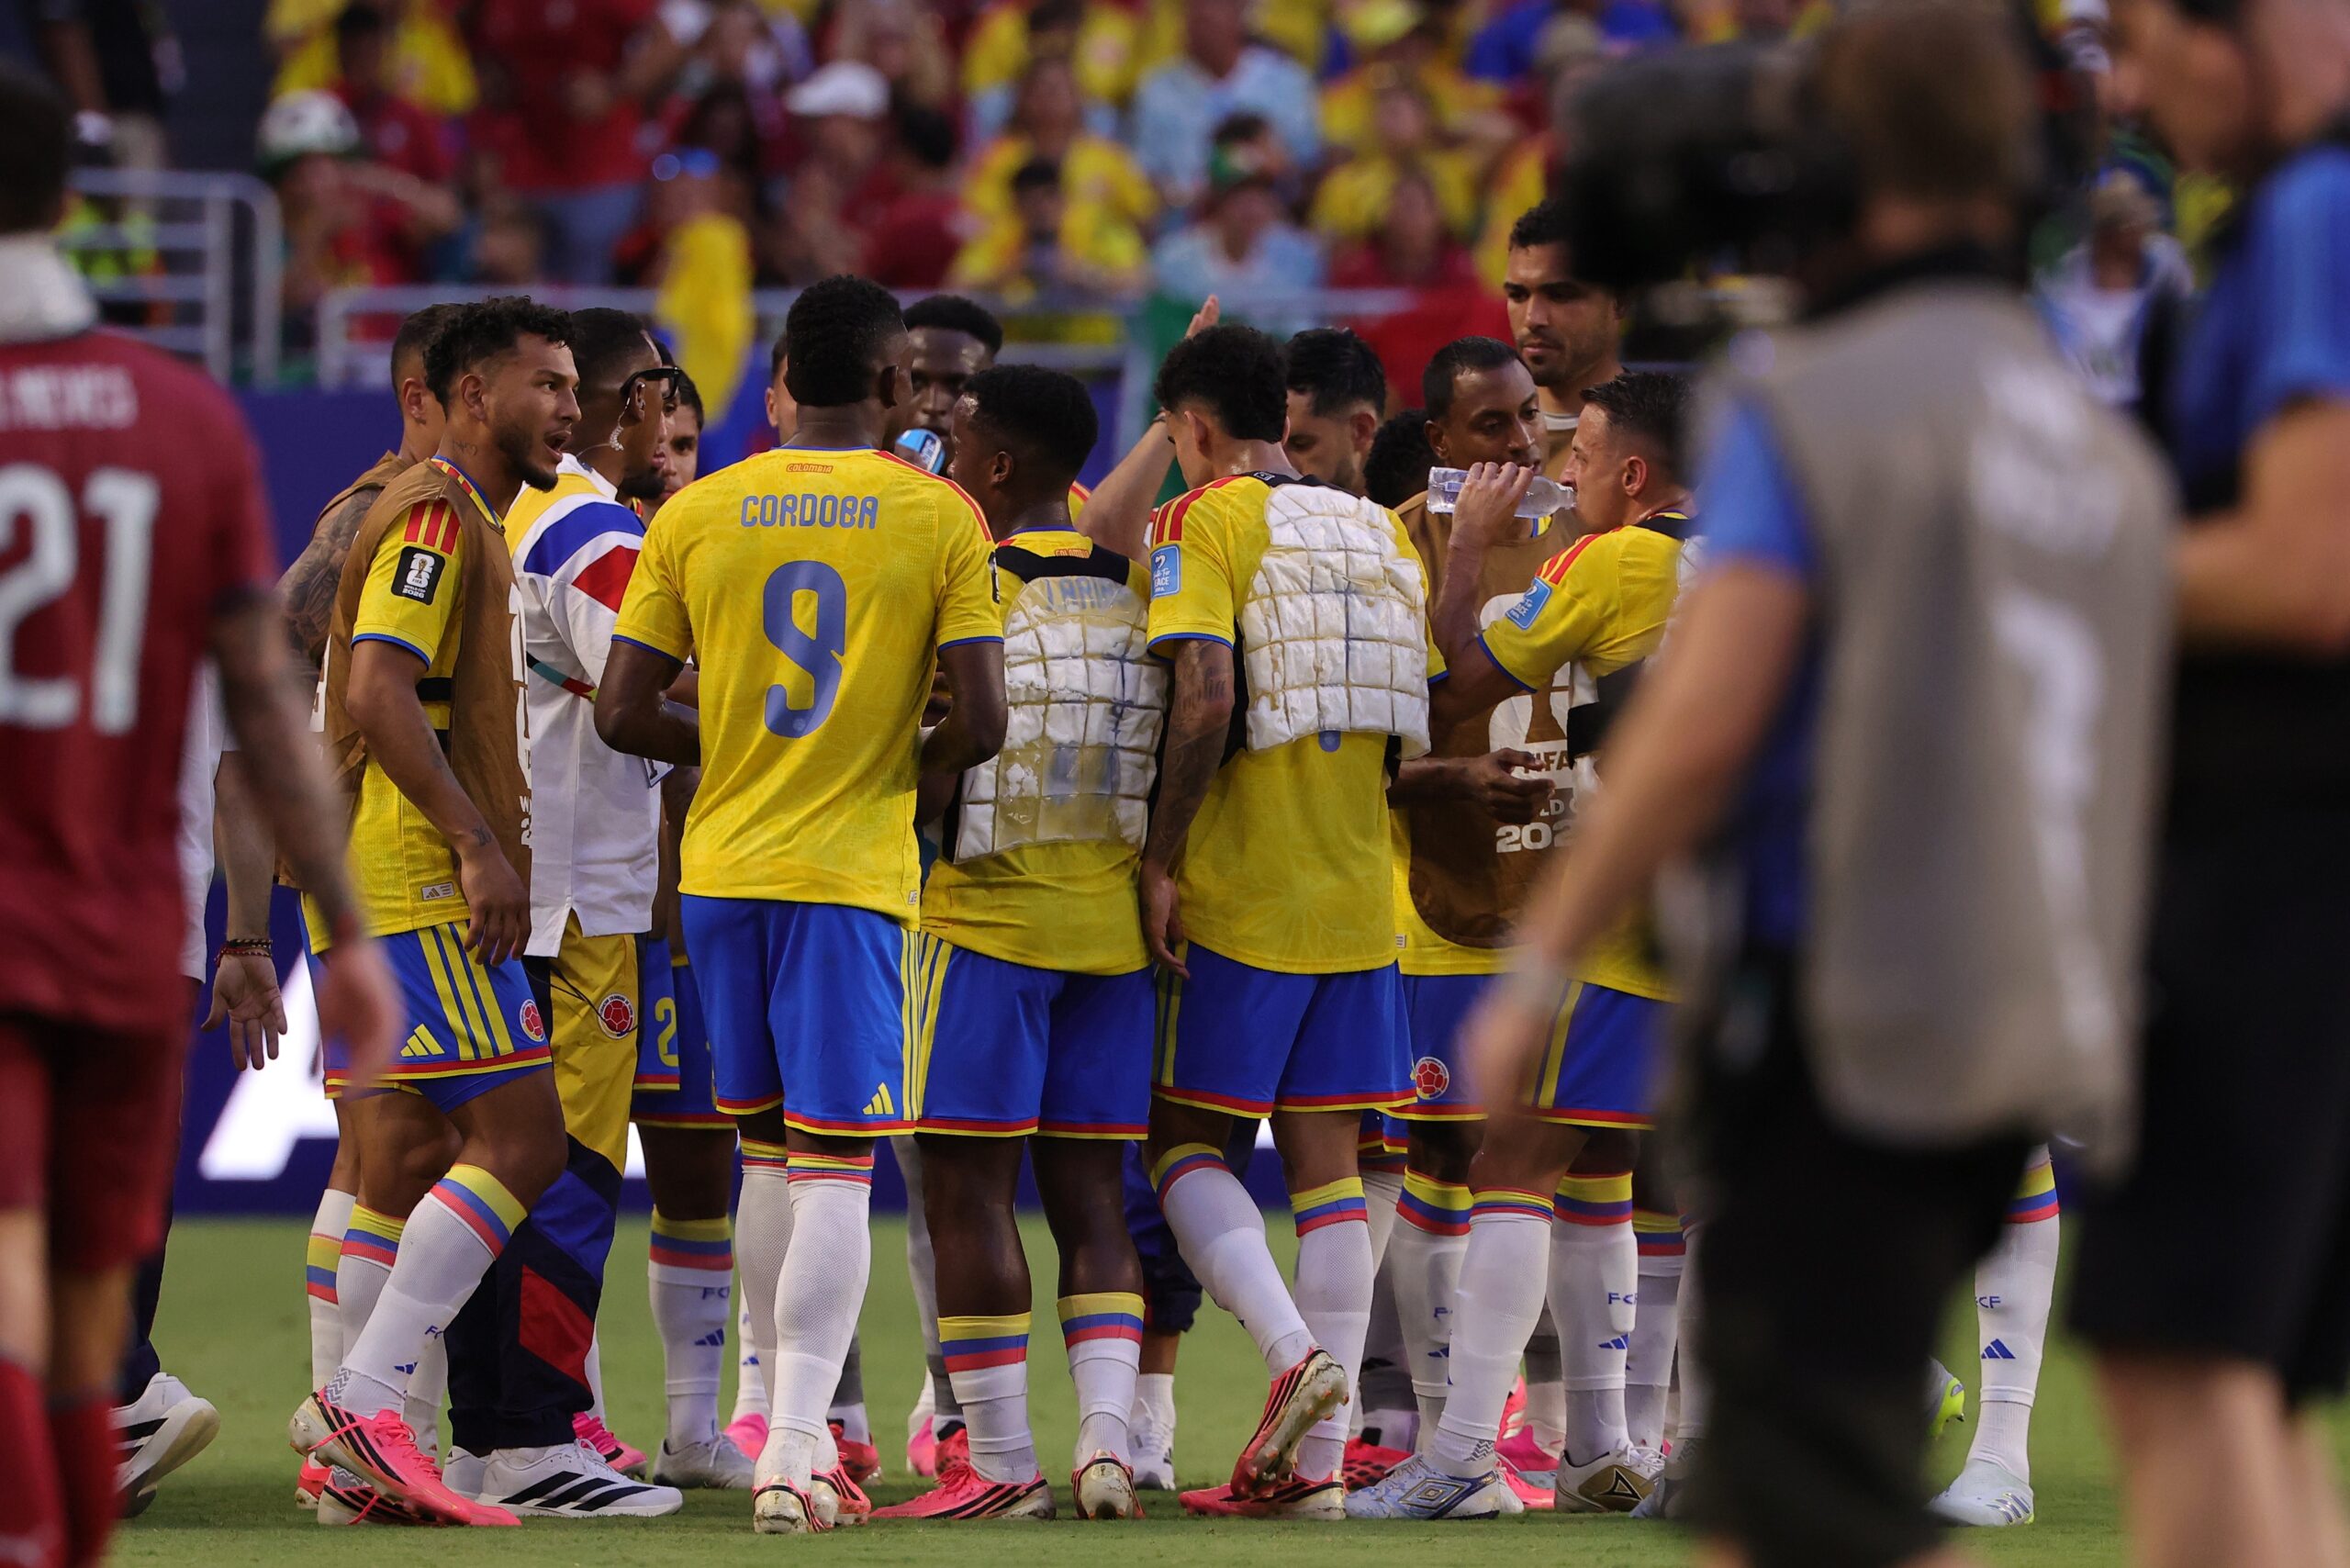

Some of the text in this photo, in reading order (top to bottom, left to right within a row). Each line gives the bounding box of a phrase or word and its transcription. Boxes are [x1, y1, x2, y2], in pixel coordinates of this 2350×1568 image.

[741, 493, 878, 530] CORDOBA
[787, 463, 834, 475] COLOMBIA
[0, 461, 162, 737] 21
[763, 559, 847, 739] 9
